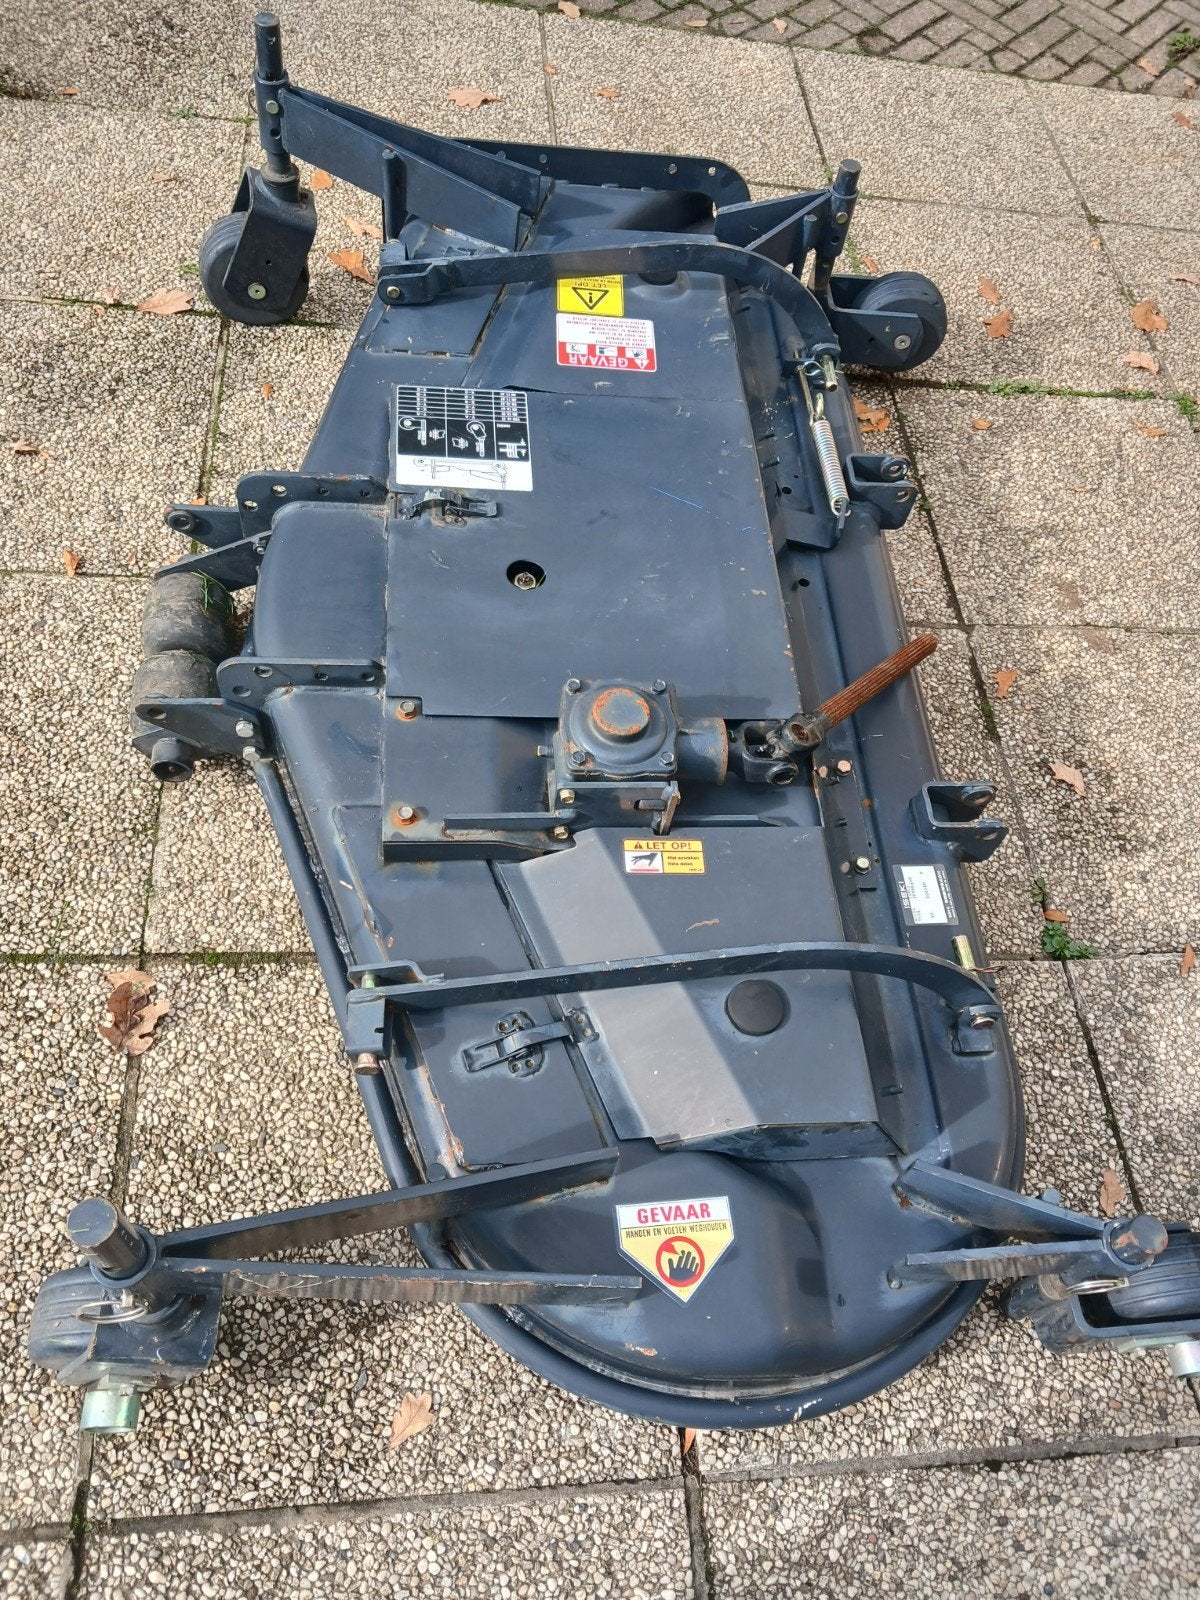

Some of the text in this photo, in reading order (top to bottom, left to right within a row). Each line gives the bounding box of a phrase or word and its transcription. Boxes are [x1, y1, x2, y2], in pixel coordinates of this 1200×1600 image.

[568, 353, 629, 368] GEVAAR
[646, 842, 691, 850] LET OP!
[898, 881, 910, 909] ISEKI
[637, 1203, 711, 1224] GEVAAR
[625, 1230, 651, 1239] HANDEN
[663, 1227, 687, 1235] VOETEN
[689, 1222, 727, 1233] WEGHOUDEN
